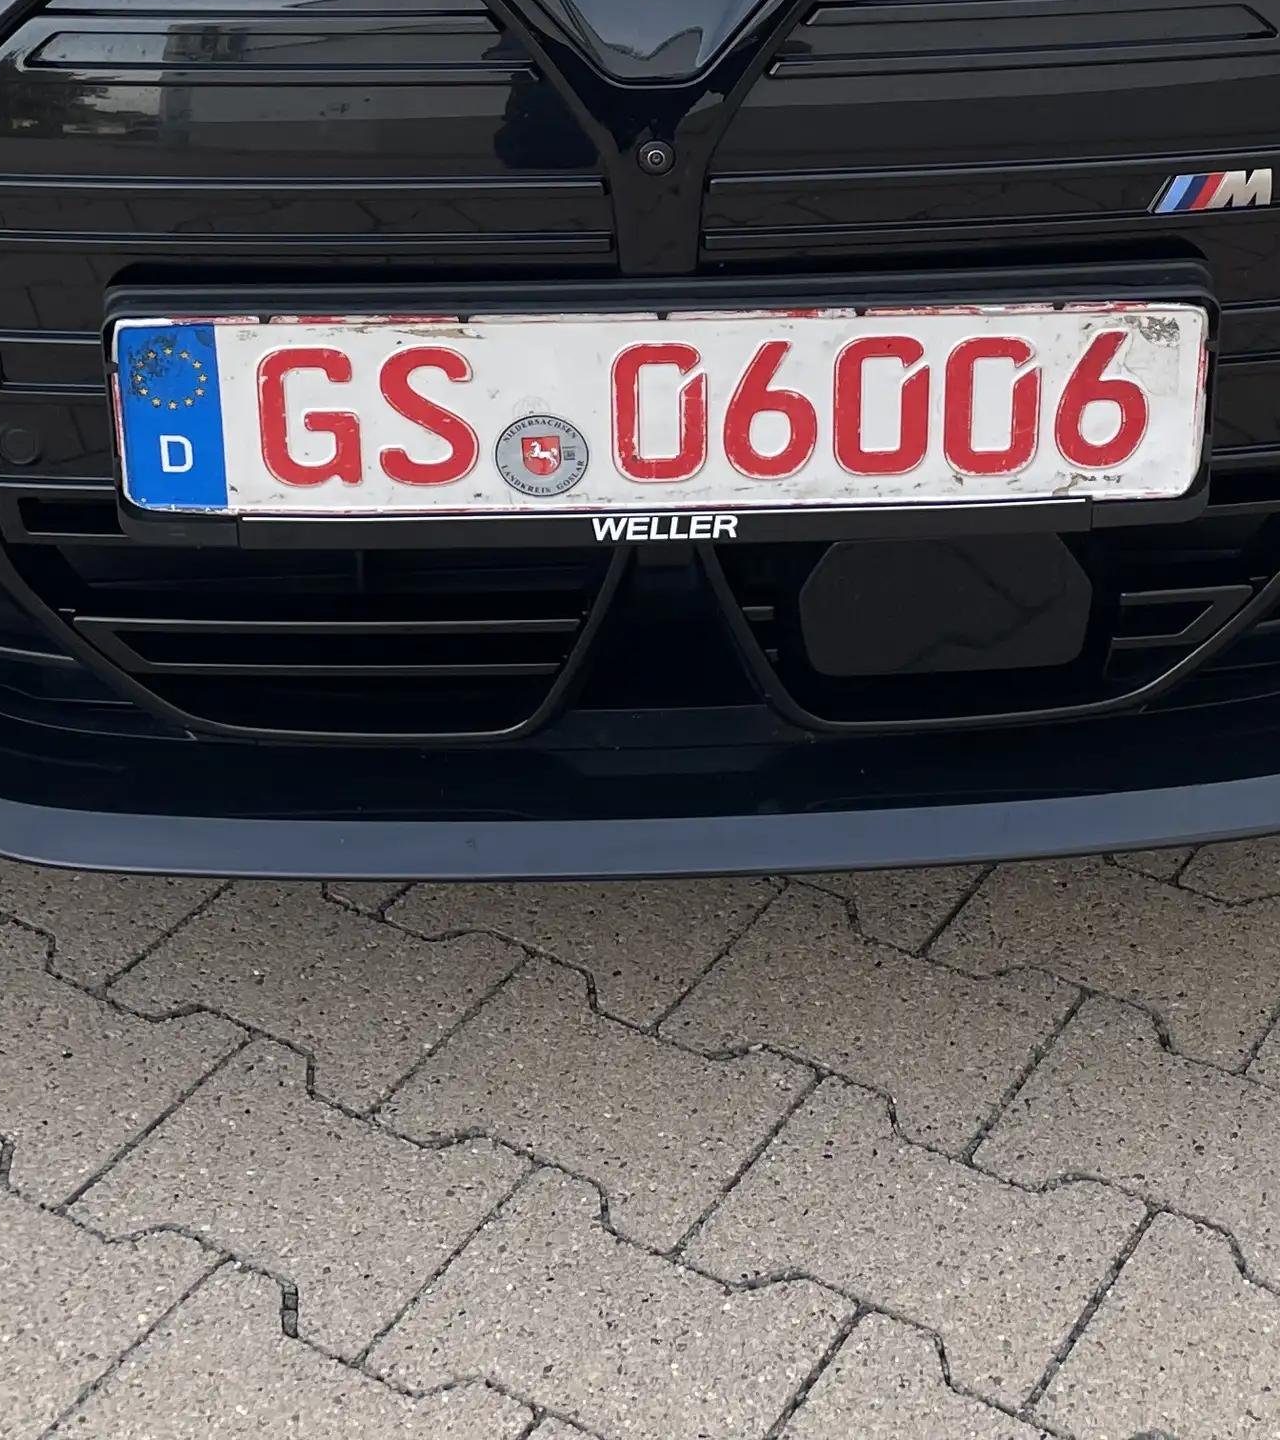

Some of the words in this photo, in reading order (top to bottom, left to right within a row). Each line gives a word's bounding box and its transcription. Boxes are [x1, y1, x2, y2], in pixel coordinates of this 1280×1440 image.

[1204, 168, 1272, 210] M
[257, 346, 480, 488] GS
[611, 331, 1149, 483] 06006
[502, 419, 577, 442] NIEDERSACHSEN
[160, 435, 193, 472] D
[501, 464, 551, 494] LANDKREIS
[556, 460, 584, 491] GOSLAR
[592, 515, 738, 541] WELLER
